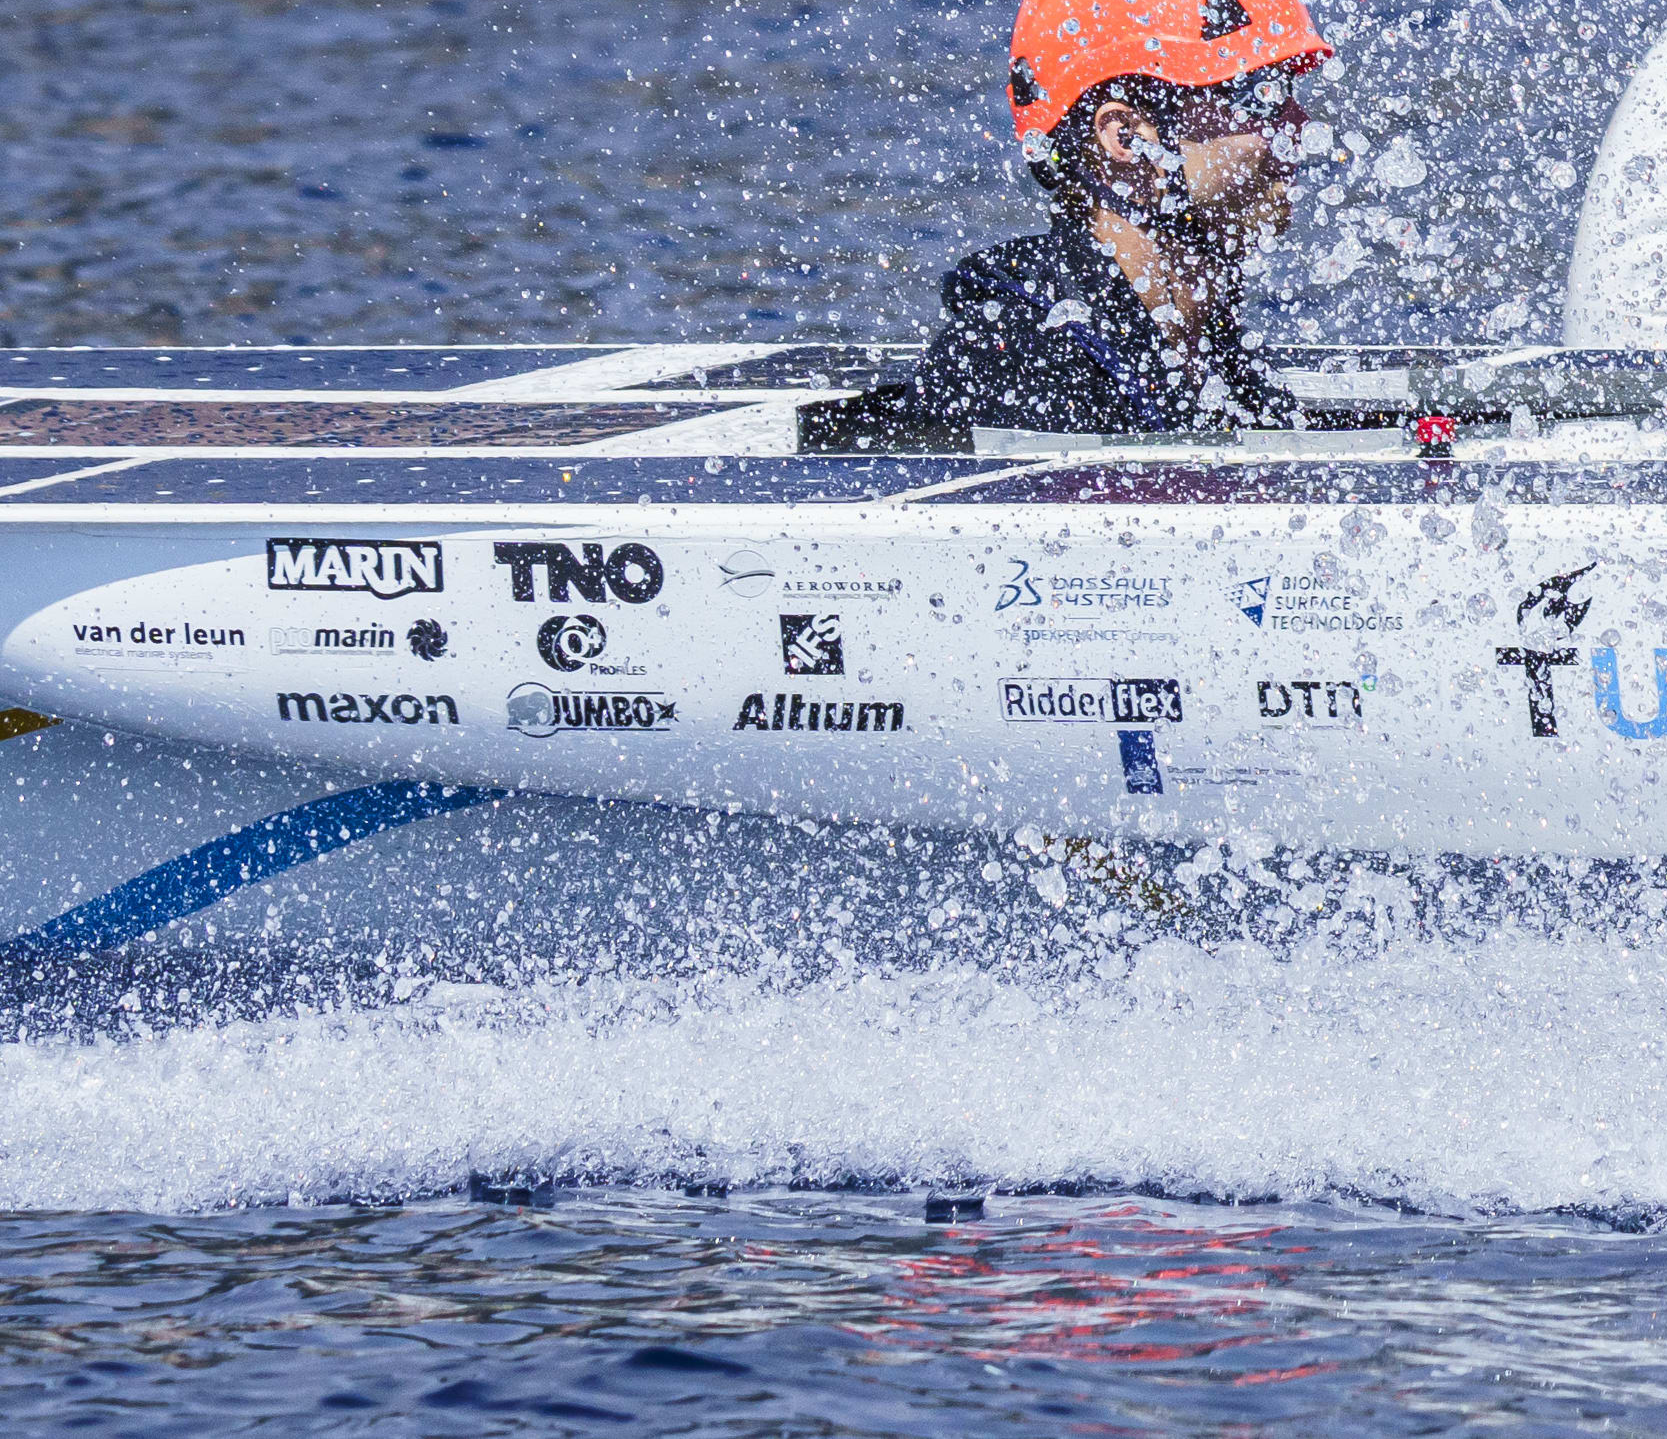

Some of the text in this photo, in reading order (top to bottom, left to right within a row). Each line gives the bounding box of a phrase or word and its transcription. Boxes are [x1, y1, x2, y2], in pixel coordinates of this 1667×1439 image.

[269, 544, 440, 597] MARIN
[493, 542, 664, 604] TNO
[783, 581, 896, 592] AEROWORK
[73, 622, 245, 645] van der leun
[276, 692, 460, 724] maxon
[550, 695, 654, 728] JUMBO
[732, 693, 904, 731] Altium
